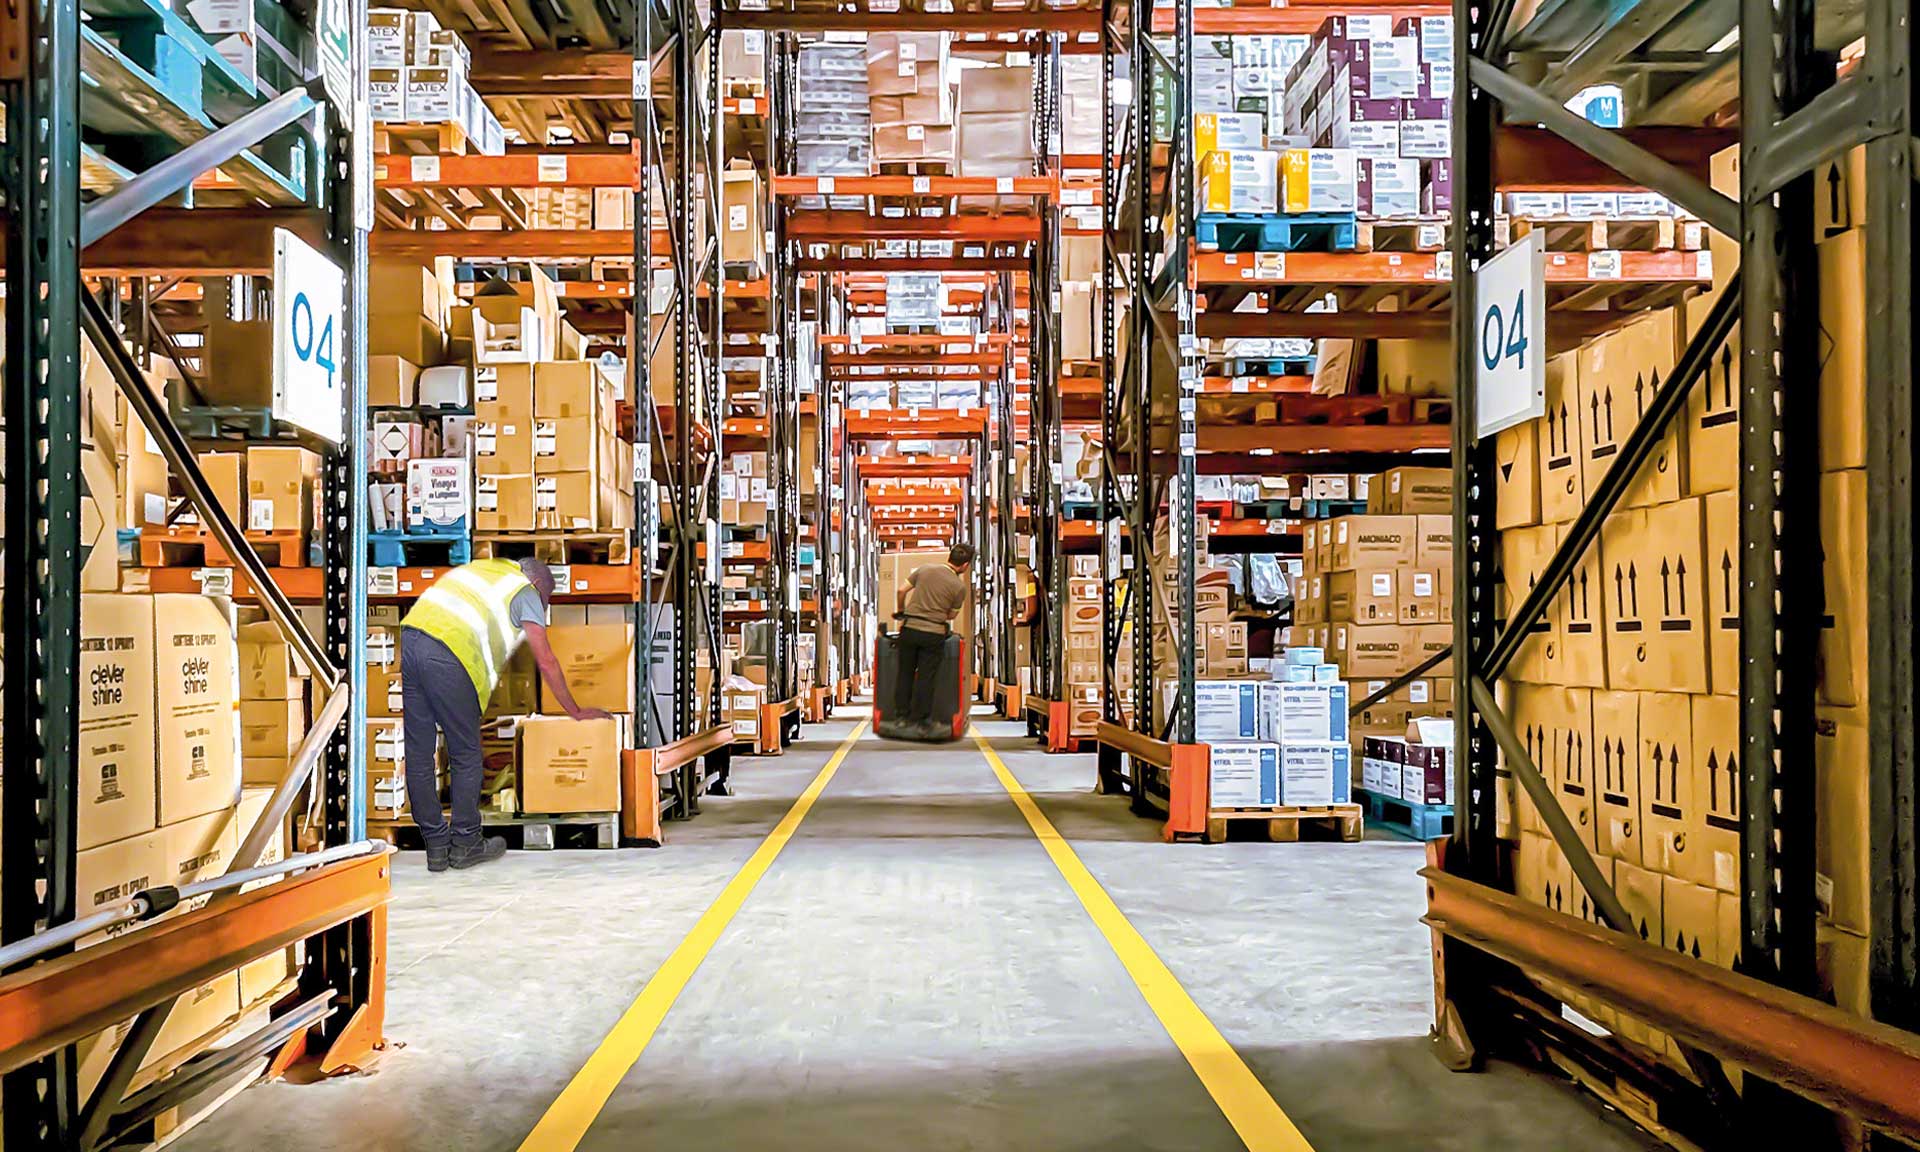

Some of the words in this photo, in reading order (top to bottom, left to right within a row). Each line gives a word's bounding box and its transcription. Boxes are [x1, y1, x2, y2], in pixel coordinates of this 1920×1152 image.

[369, 27, 399, 37] ATEX
[369, 83, 398, 92] ATEX
[408, 83, 447, 93] LATEX
[1600, 98, 1613, 112] M
[1199, 116, 1215, 129] XL
[1212, 153, 1228, 166] XL
[1289, 152, 1306, 165] XL
[1482, 288, 1527, 370] 04
[292, 291, 335, 389] 04
[1357, 534, 1402, 544] AMONIACO
[184, 678, 207, 695] shine
[92, 685, 122, 706] shine
